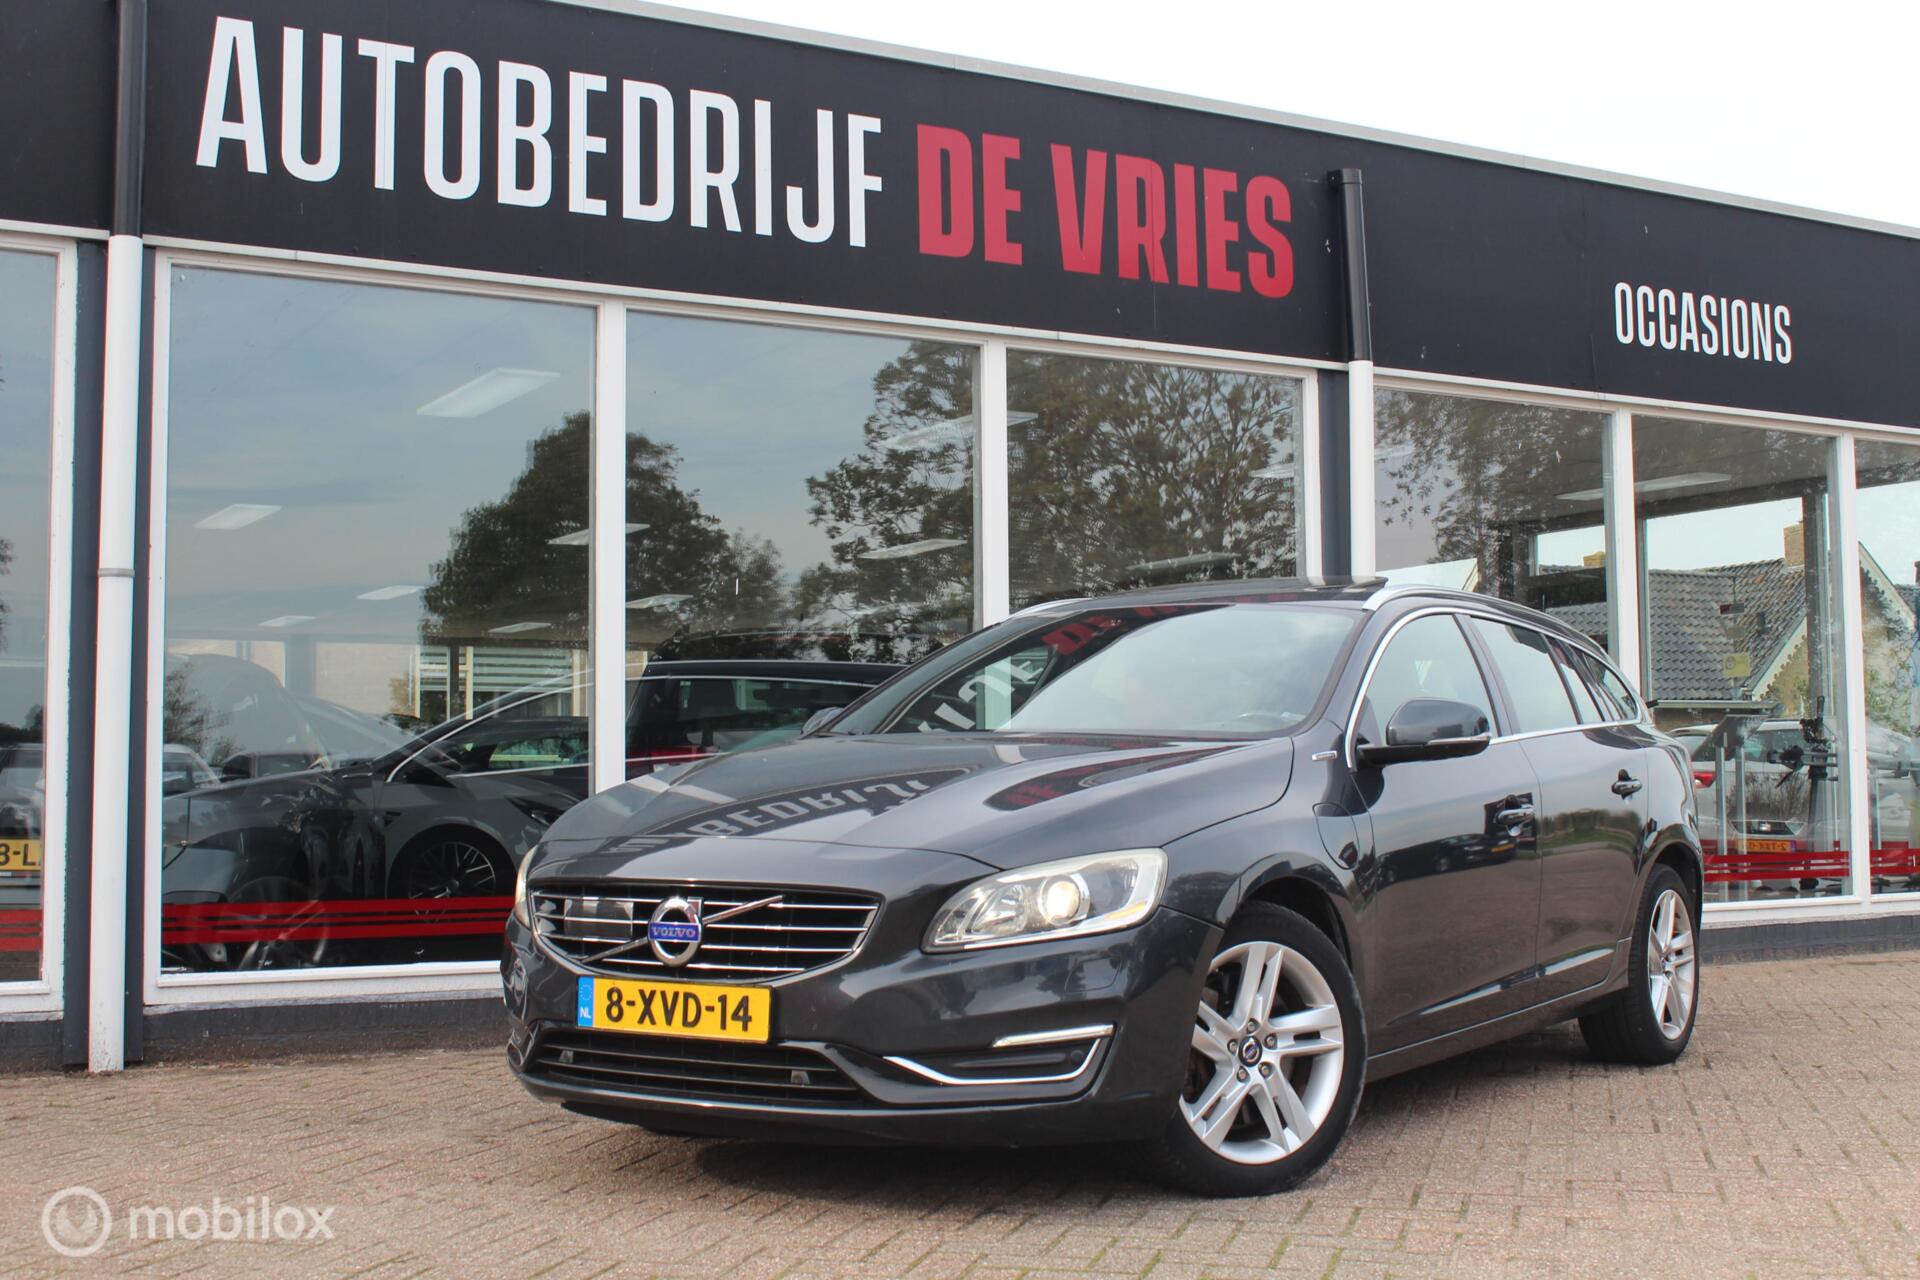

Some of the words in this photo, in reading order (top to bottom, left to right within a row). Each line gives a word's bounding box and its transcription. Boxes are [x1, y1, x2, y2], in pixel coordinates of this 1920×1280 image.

[196, 16, 883, 248] AUTOBEDRIJF
[916, 123, 1024, 266] DE
[1050, 143, 1295, 299] VRIES
[1614, 281, 1793, 365] OCCASIONS
[652, 926, 697, 939] VOLVO
[580, 1007, 592, 1019] NL
[605, 986, 753, 1033] 8-XVD-14
